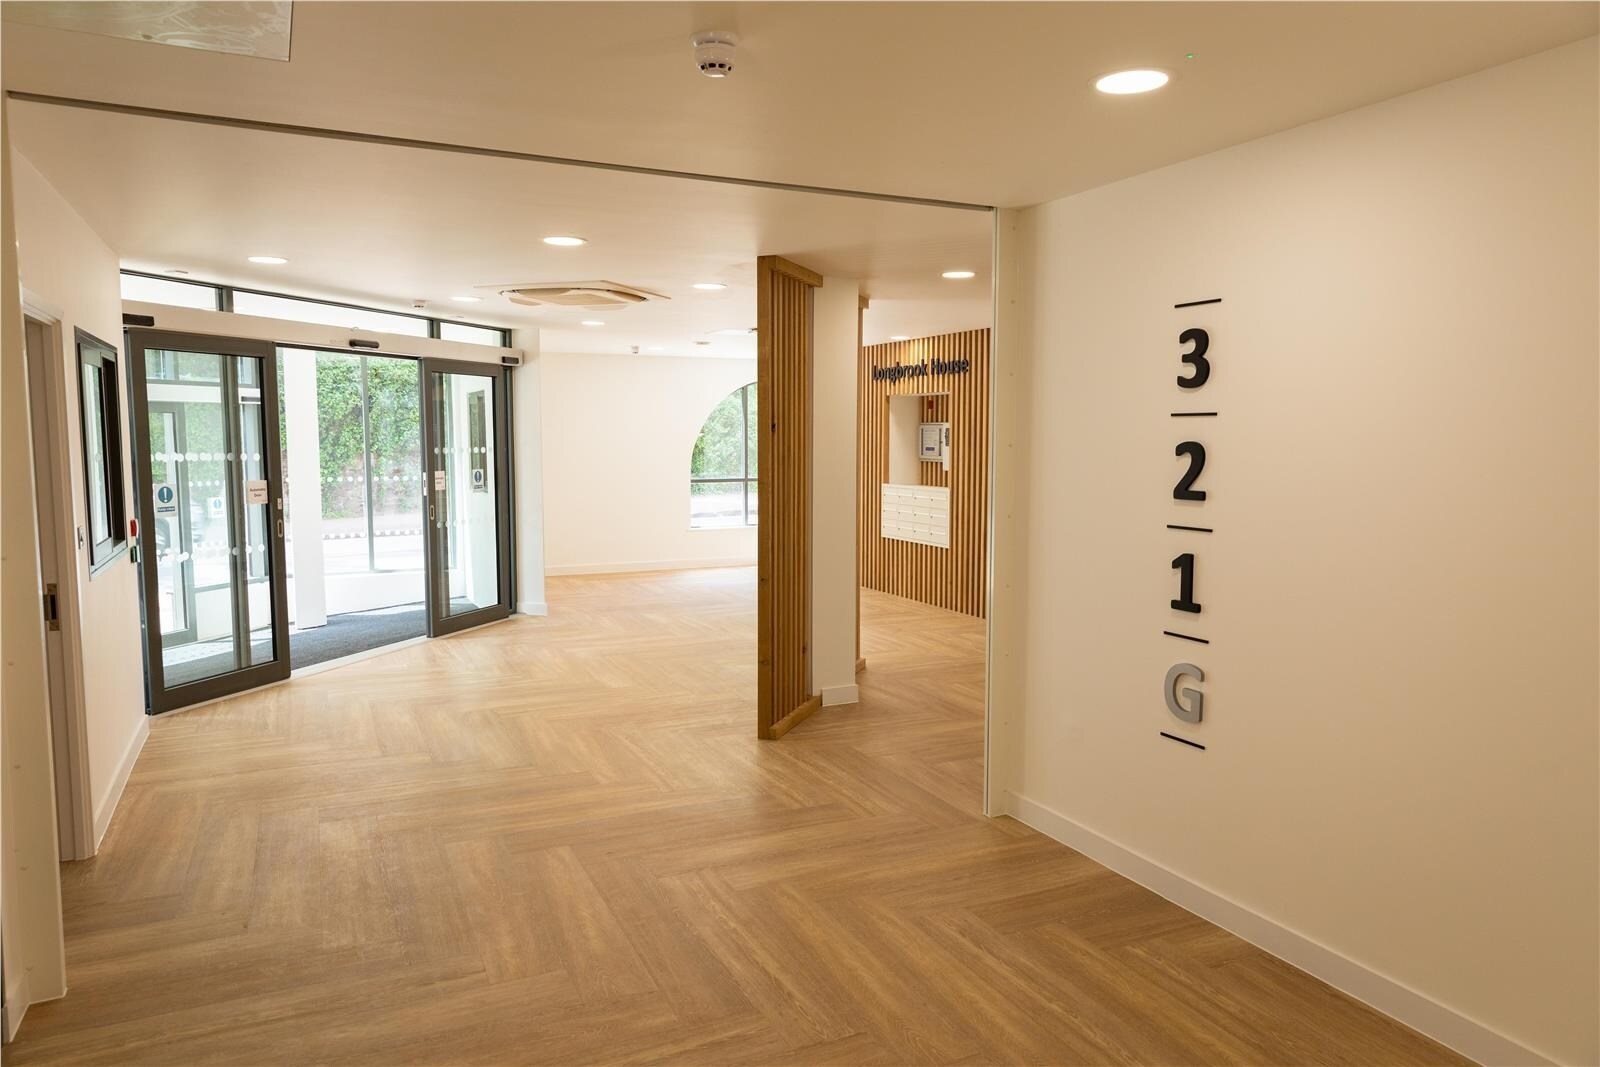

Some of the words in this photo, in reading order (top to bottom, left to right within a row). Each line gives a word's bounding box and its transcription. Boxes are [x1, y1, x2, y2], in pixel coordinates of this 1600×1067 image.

[872, 359, 928, 385] Longbrook
[930, 357, 969, 376] House
[1177, 328, 1210, 389] 3
[1173, 441, 1207, 502] 2
[1171, 553, 1201, 613] 1
[1164, 662, 1205, 724] G
